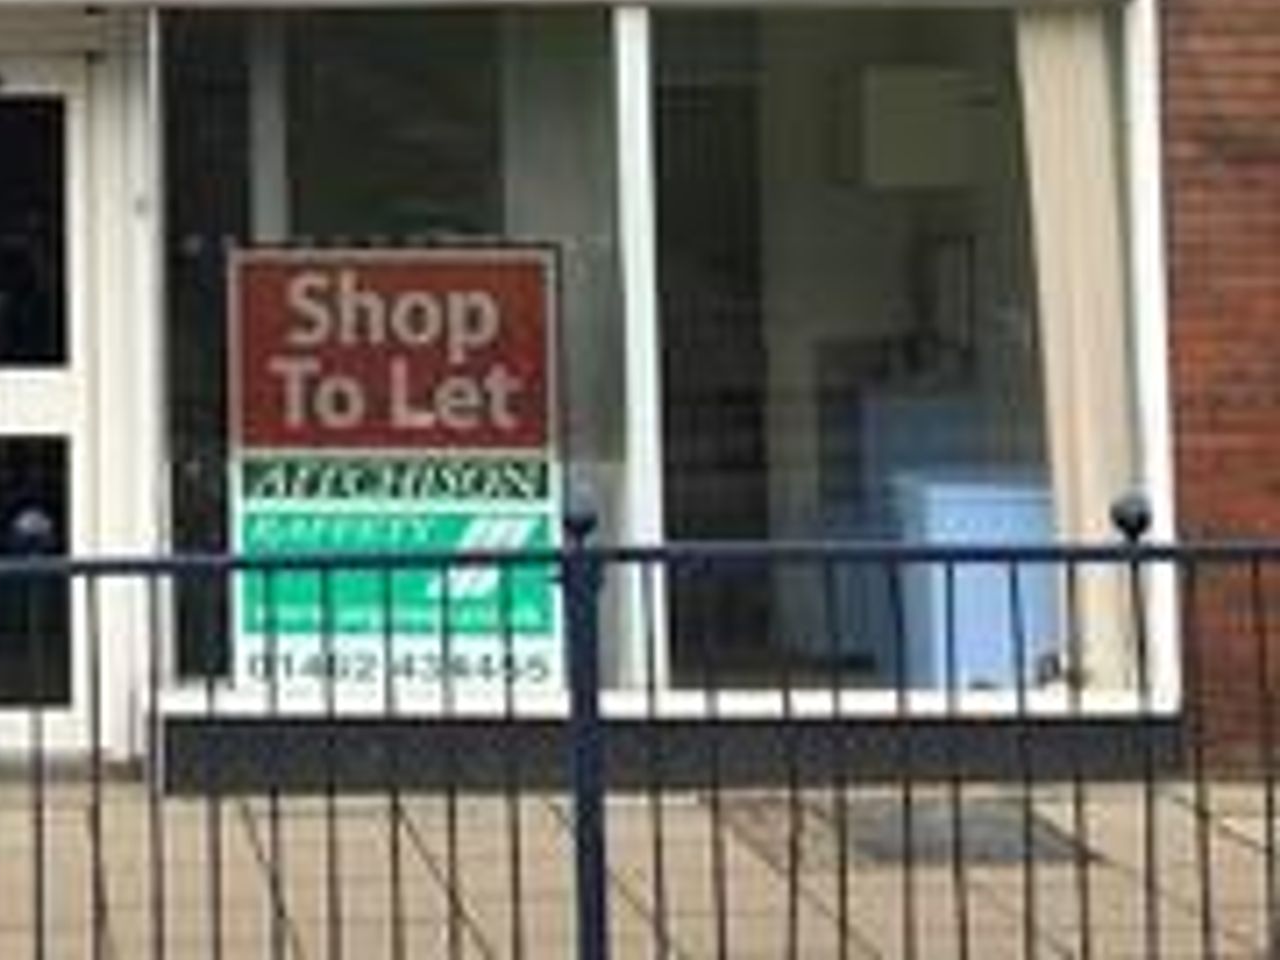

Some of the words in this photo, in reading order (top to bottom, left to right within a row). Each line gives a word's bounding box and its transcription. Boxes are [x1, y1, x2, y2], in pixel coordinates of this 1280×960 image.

[286, 269, 501, 362] Shop
[269, 355, 366, 427] To
[389, 357, 521, 427] Let
